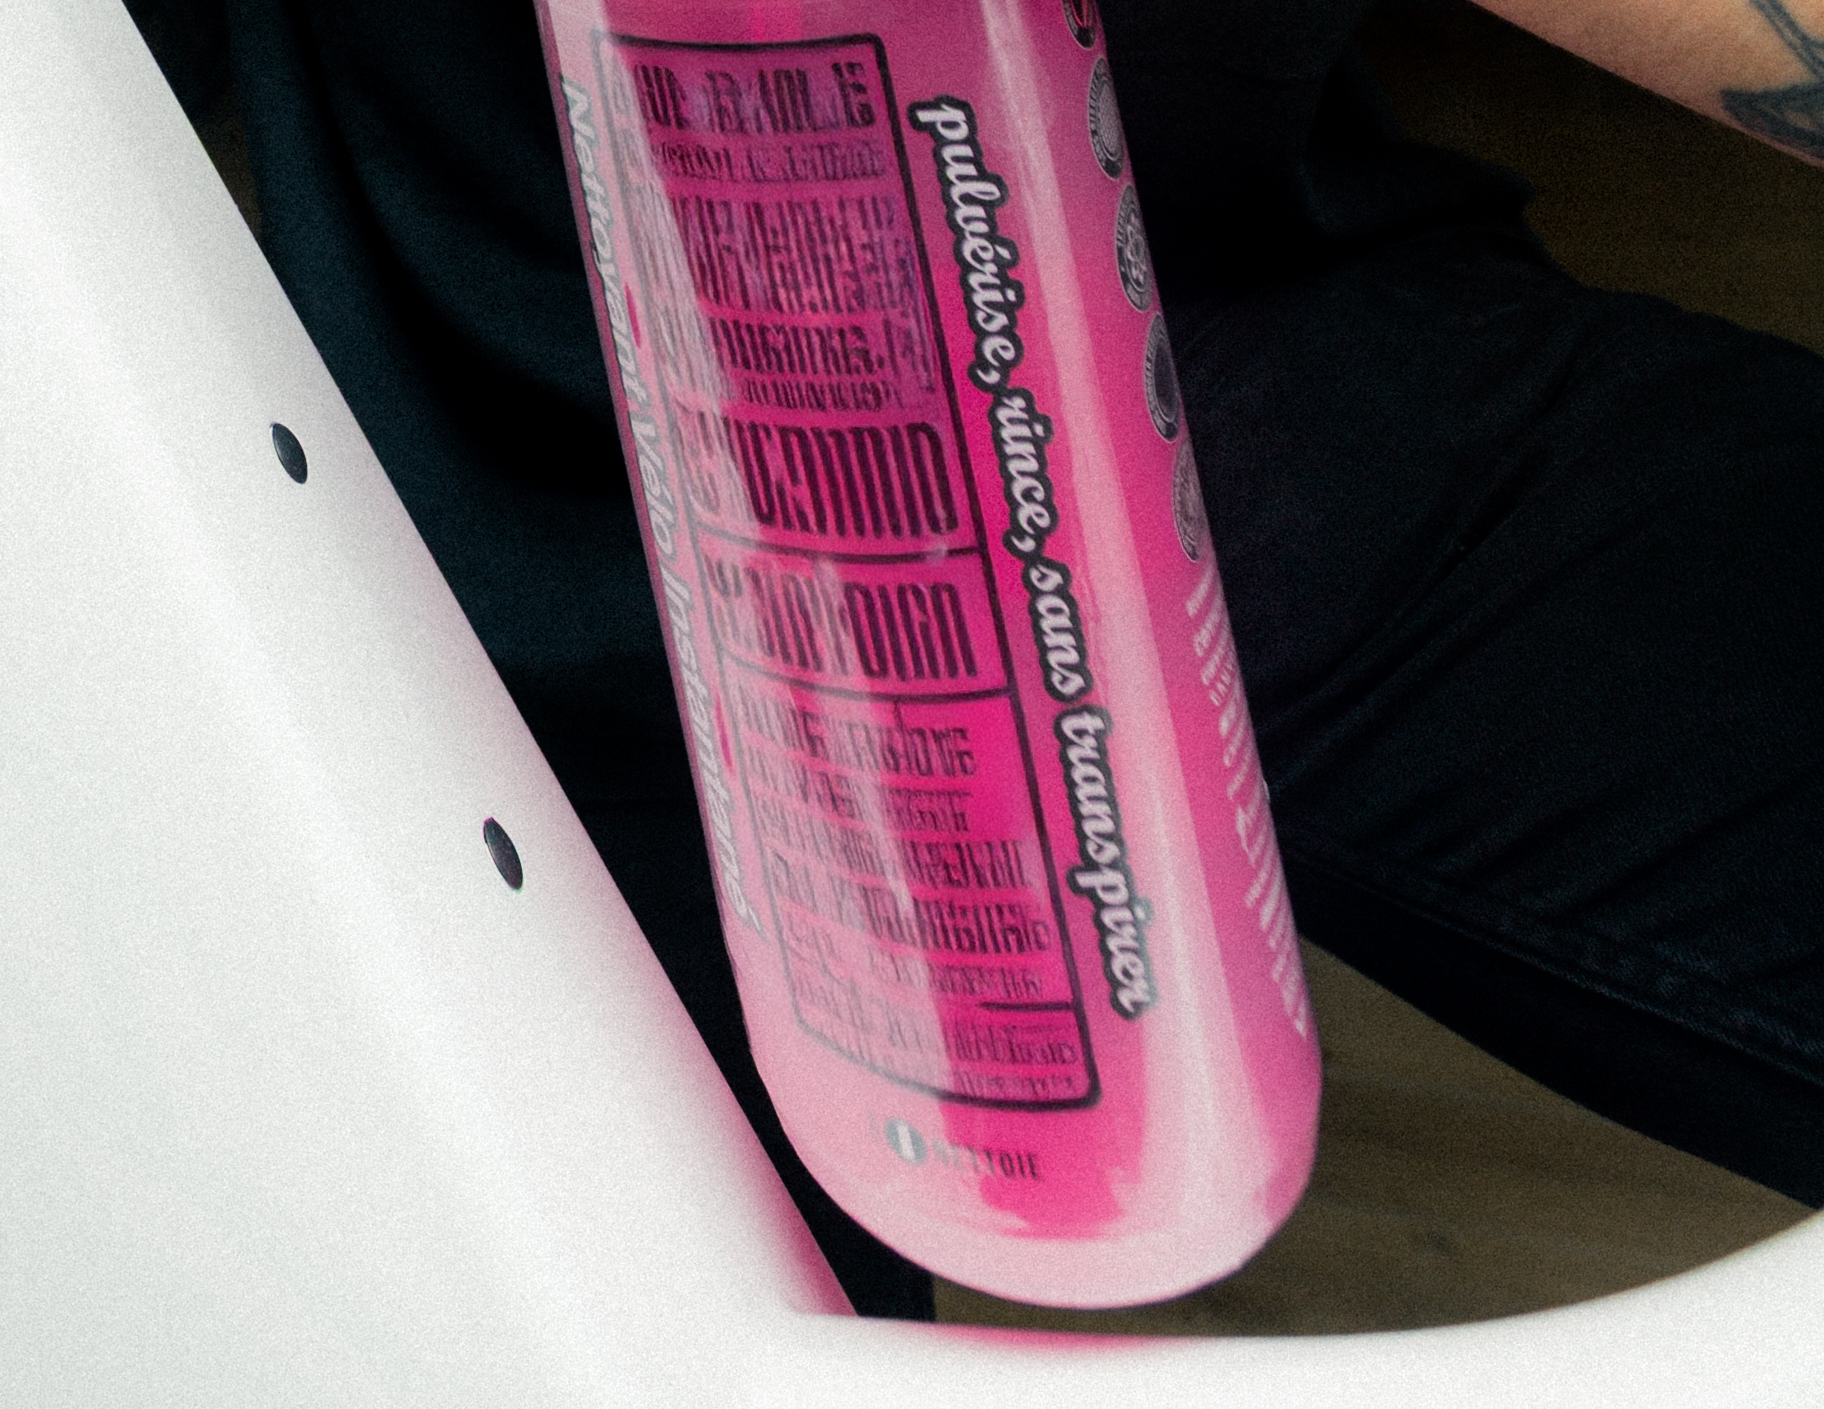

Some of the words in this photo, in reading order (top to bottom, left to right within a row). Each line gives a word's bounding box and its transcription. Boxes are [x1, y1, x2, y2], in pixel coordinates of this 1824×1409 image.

[562, 78, 651, 408] Nettoyant
[662, 566, 765, 939] Instantané
[913, 96, 1021, 386] pulvérise,
[992, 390, 1054, 556] rince,
[1026, 562, 1088, 694] sans
[1060, 707, 1155, 1016] transpirer
